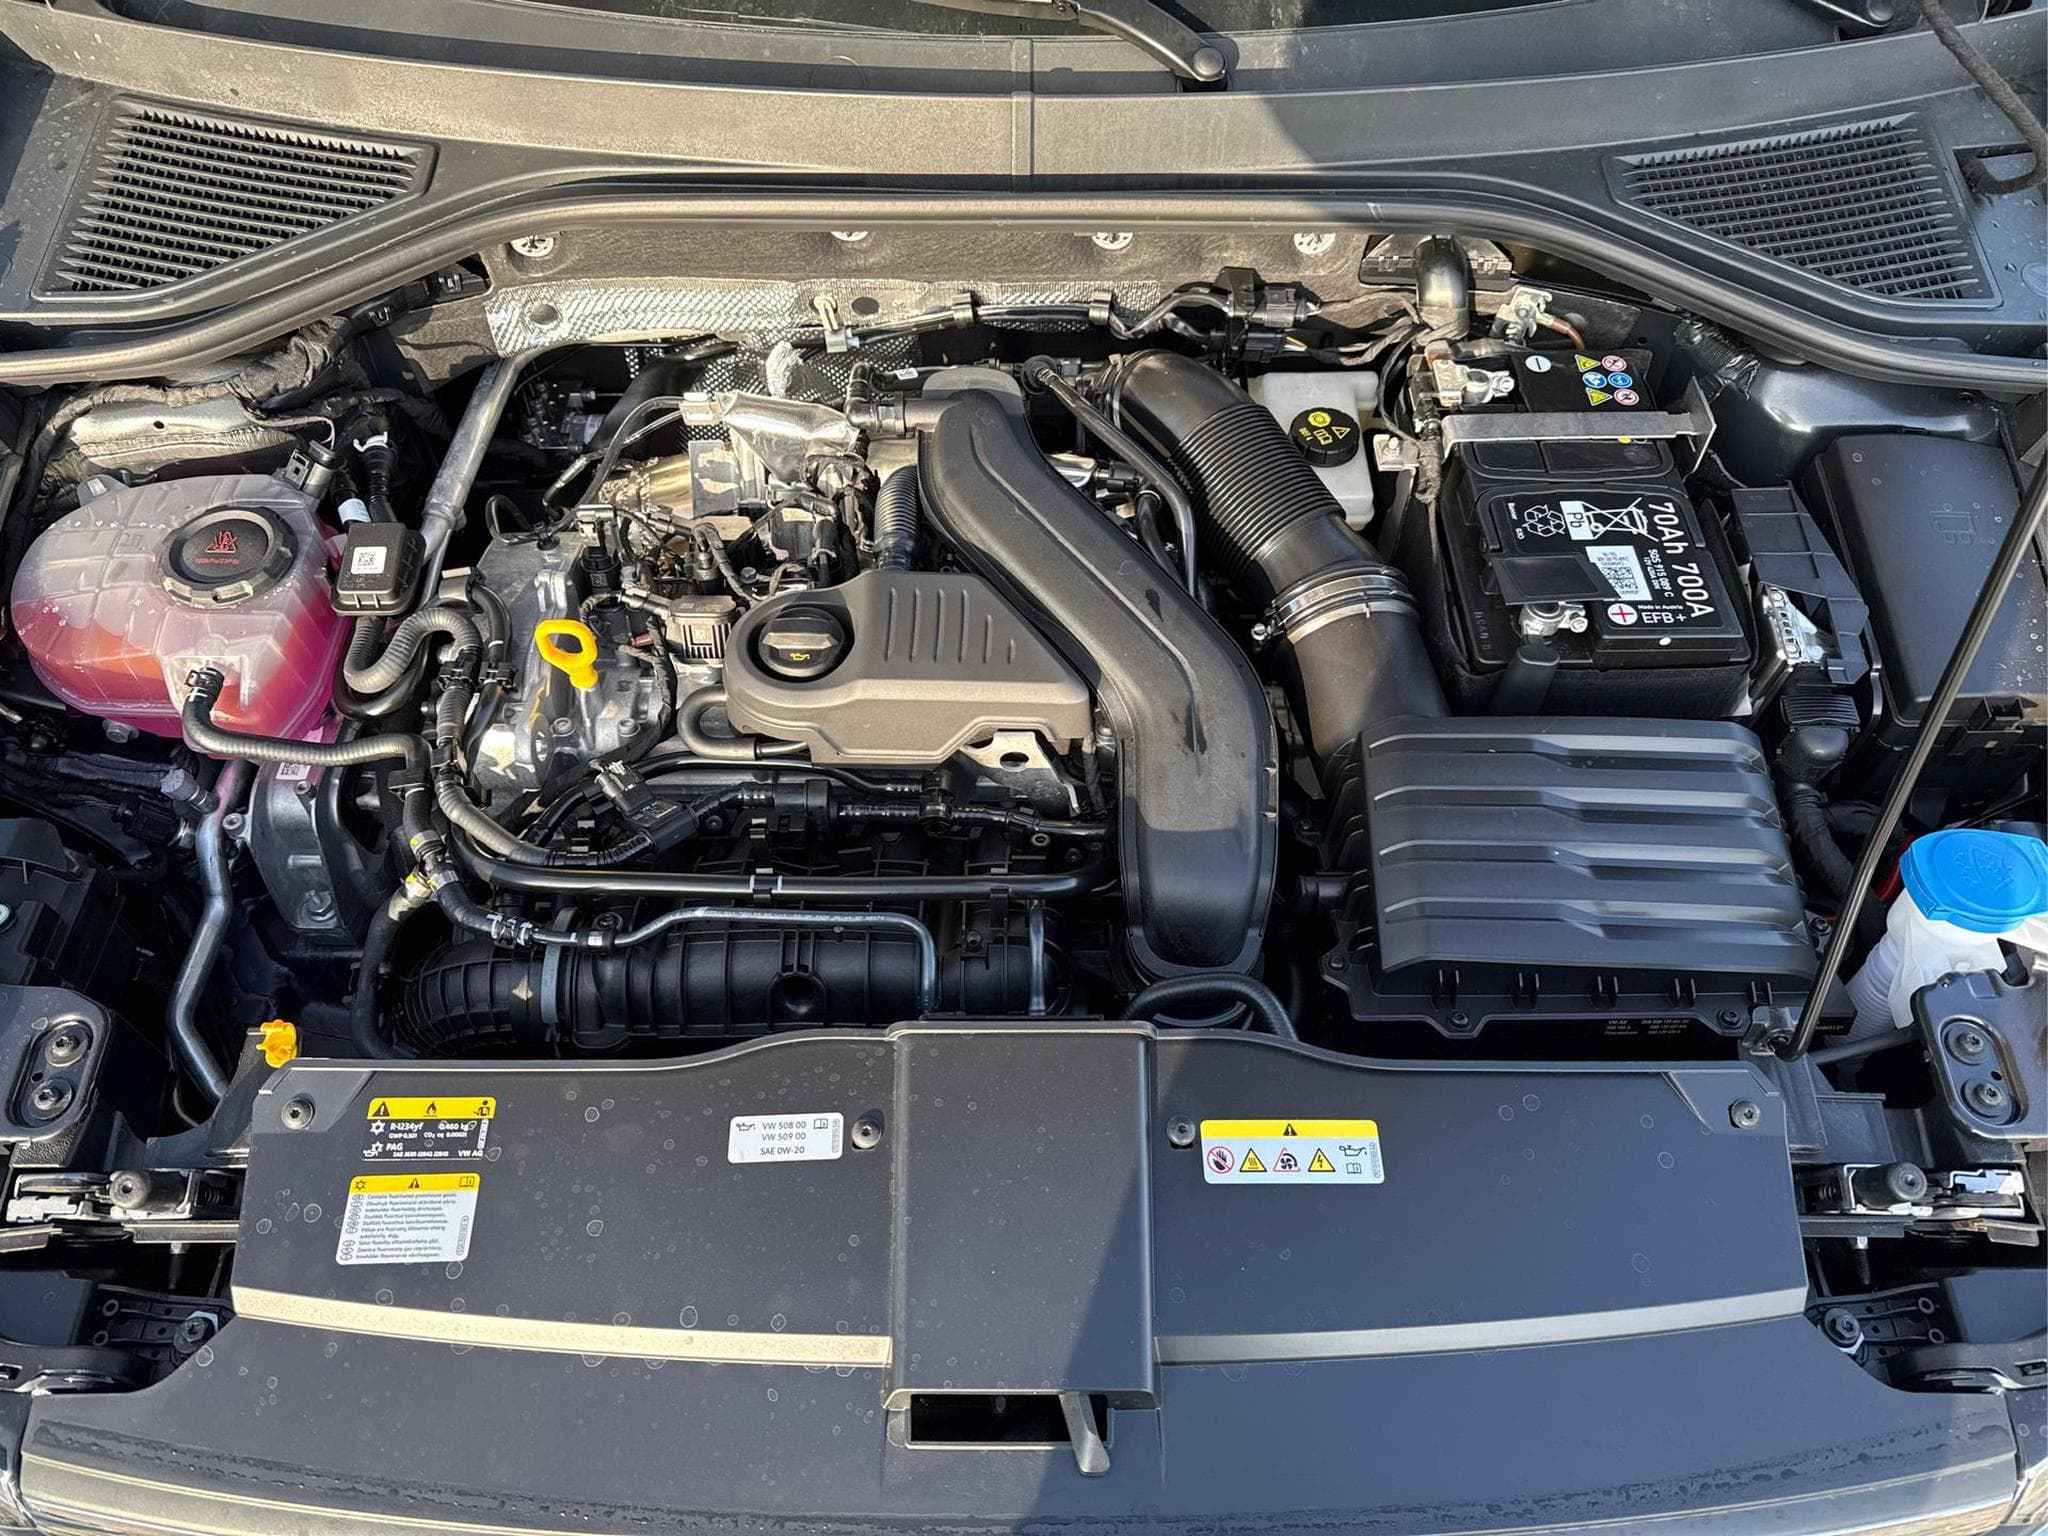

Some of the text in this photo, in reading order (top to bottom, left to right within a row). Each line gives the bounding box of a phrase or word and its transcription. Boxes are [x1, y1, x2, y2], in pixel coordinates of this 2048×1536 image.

[1566, 512, 1585, 528] Pb
[1648, 502, 1689, 554] 70Ah
[1671, 563, 1715, 618] 700A
[1641, 611, 1675, 624] EFB
[389, 1121, 425, 1133] R-1234yf
[762, 1121, 807, 1130] VW 508 00
[761, 1132, 807, 1141] VW 509 00
[386, 1142, 404, 1151] PAG
[760, 1146, 806, 1155] SAE 0W-20
[458, 1149, 485, 1157] VW AG
